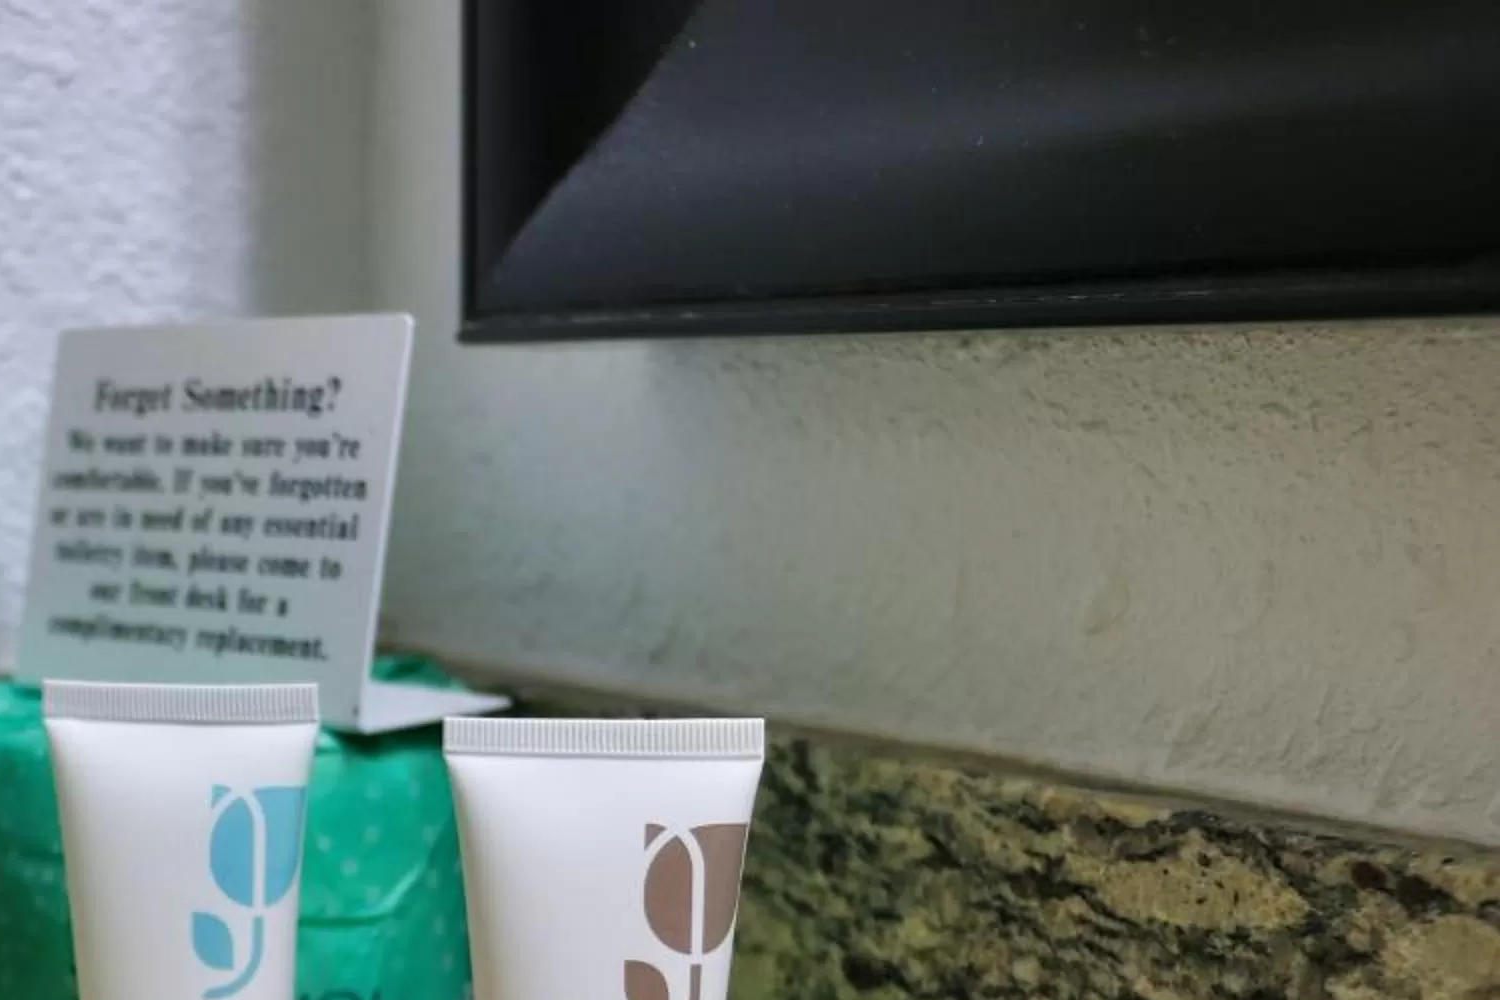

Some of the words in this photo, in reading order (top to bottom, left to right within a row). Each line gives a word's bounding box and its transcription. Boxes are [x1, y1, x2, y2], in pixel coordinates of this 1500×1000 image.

[181, 375, 341, 419] Something?
[181, 432, 232, 457] make
[242, 437, 286, 458] sure
[293, 430, 360, 464] you're
[269, 469, 367, 504] forgotten
[141, 504, 184, 532] need
[220, 515, 254, 541] any
[263, 512, 358, 541] essential
[258, 556, 310, 579] come
[320, 556, 343, 580] to
[238, 586, 268, 616] for
[276, 596, 288, 618] a
[196, 624, 329, 661] replacement.
